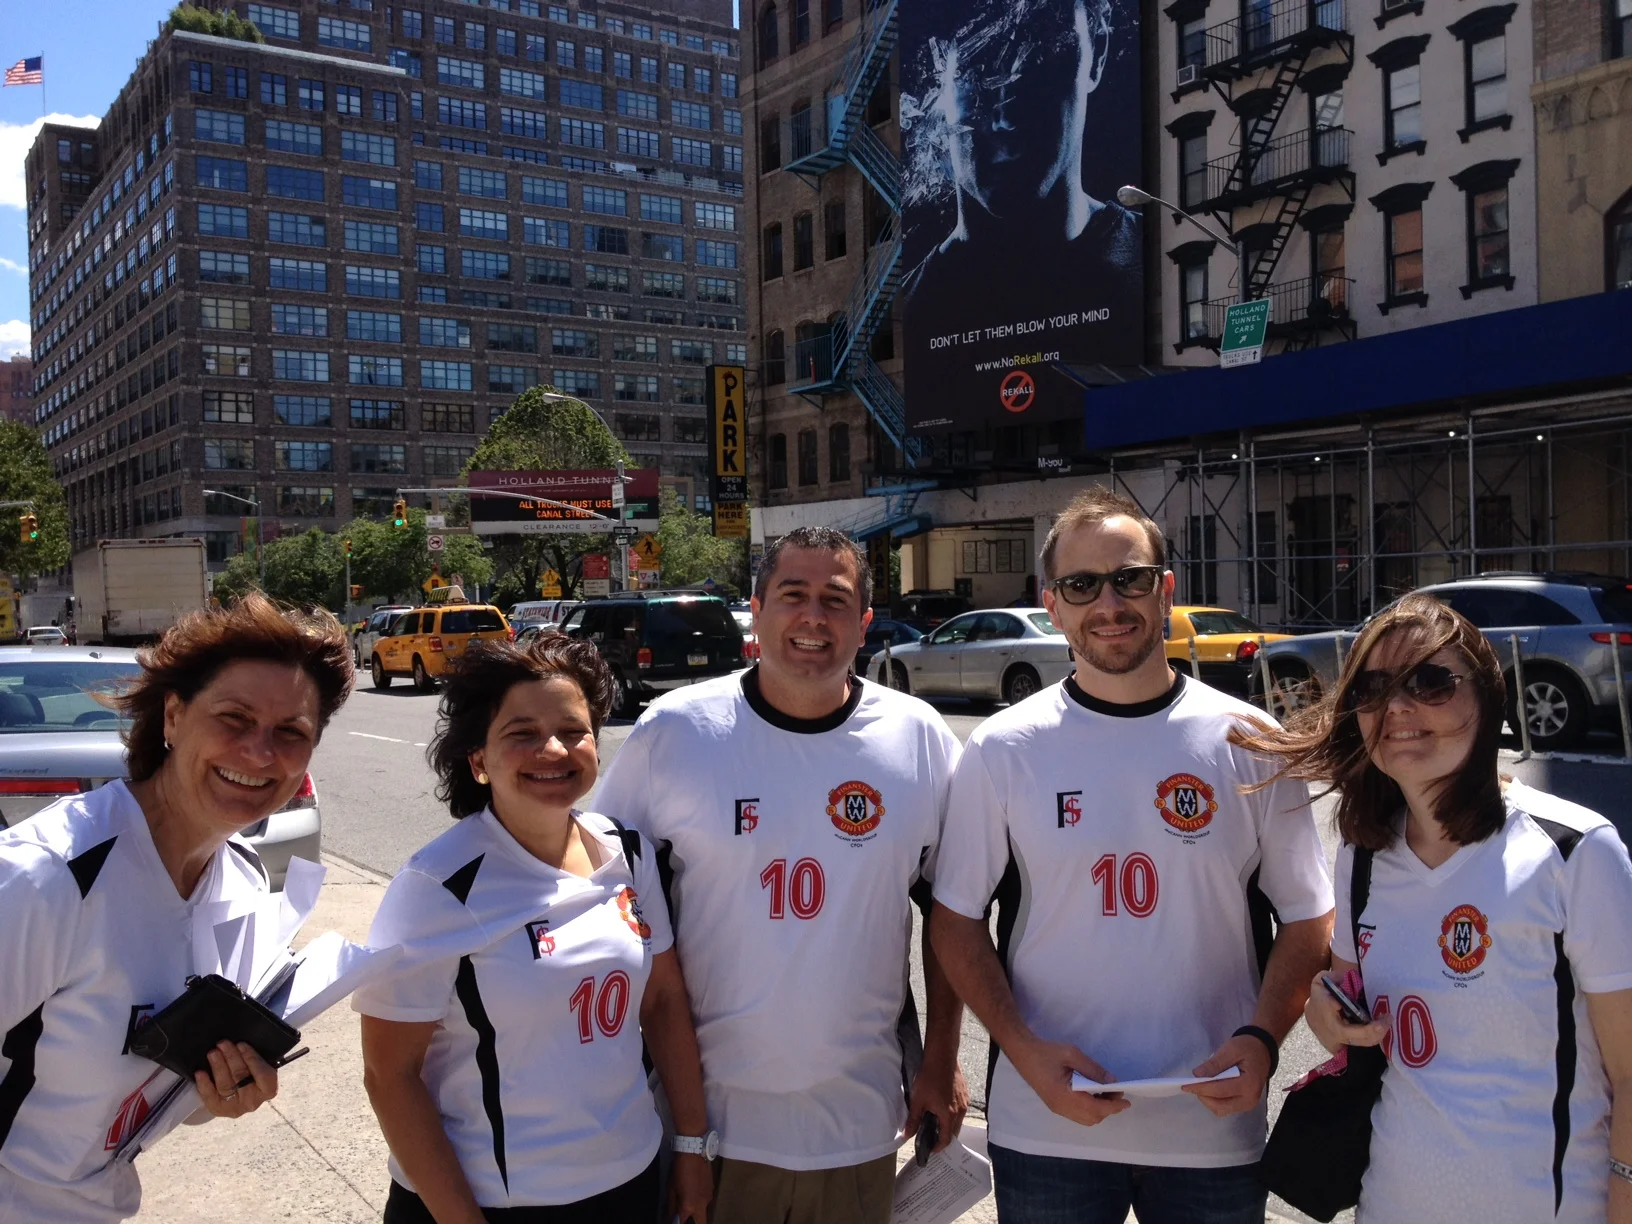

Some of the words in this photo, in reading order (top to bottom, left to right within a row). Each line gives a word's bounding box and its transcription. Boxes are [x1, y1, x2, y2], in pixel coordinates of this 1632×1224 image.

[1229, 305, 1266, 316] HOLLAND
[1232, 315, 1261, 325] TUNNEL
[930, 334, 960, 349] DON'T
[962, 330, 981, 344] LET
[985, 324, 1014, 340] THEM
[1016, 319, 1045, 335] BLOW
[1049, 313, 1078, 329] YOUR
[1082, 308, 1110, 323] MIND
[1234, 325, 1255, 334] CARS
[975, 351, 1060, 372] www.NoRekall.org
[1002, 385, 1034, 397] REKALL
[722, 371, 739, 472] PARK
[499, 476, 566, 485] HOLLAND
[572, 476, 631, 485] TUNNEL
[519, 500, 534, 509] ALL
[570, 499, 593, 509] MUST
[596, 499, 612, 508] USE
[718, 503, 743, 511] PARK
[536, 510, 563, 518] CANAL
[718, 511, 743, 519] HERE
[523, 523, 581, 531] CLEARANCE
[1166, 776, 1204, 789] FINANSTER
[840, 822, 873, 832] UNITED
[1170, 817, 1205, 828] UNITED
[760, 857, 826, 920] 10
[1091, 852, 1159, 918] 10
[1447, 957, 1477, 969] UNITED
[569, 969, 630, 1044] 10
